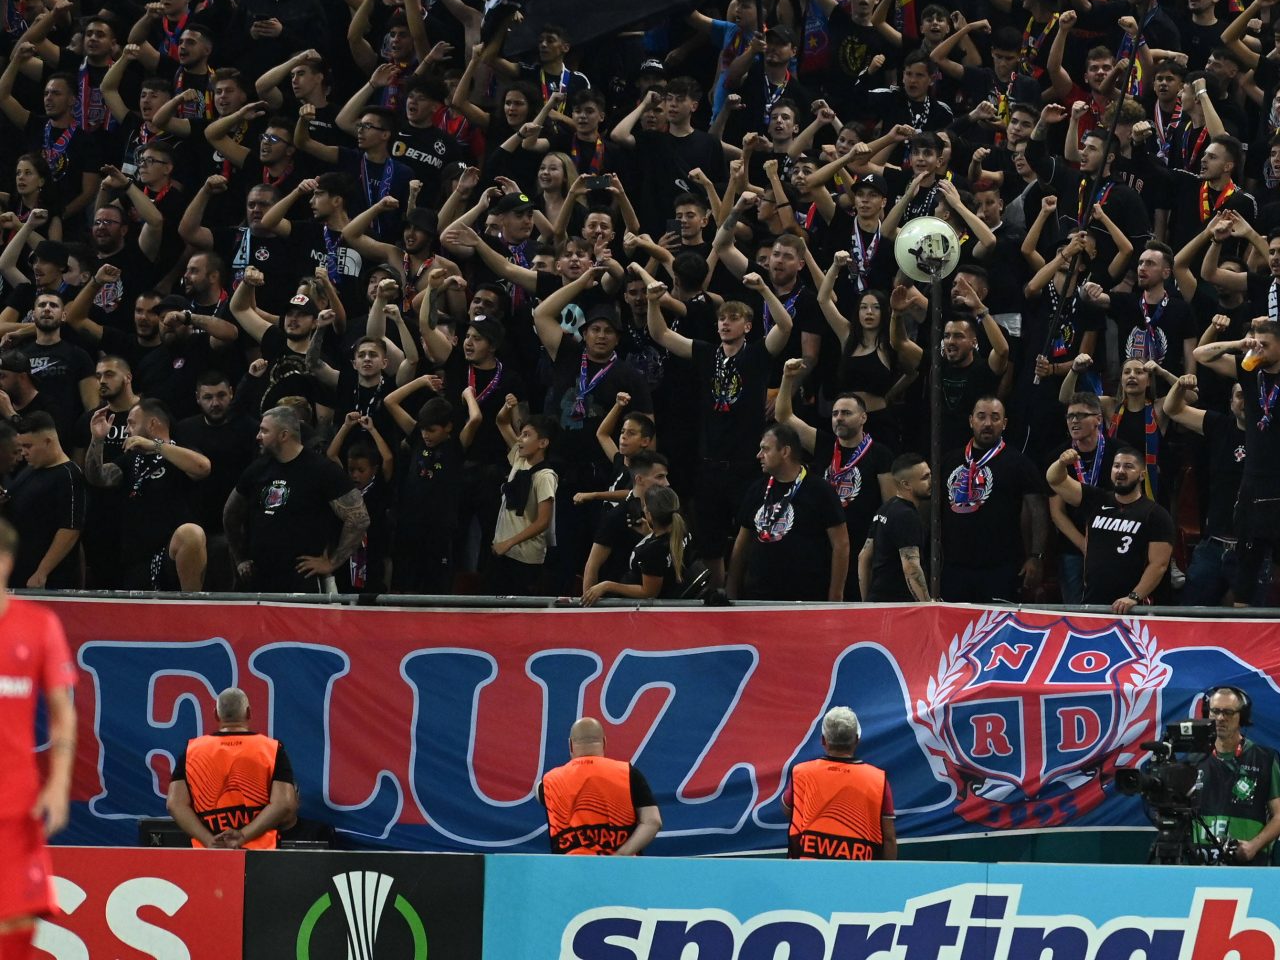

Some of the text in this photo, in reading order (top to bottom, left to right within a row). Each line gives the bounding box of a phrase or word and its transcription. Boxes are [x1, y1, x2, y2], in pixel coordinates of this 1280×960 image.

[405, 148, 443, 169] BETANO
[1092, 515, 1141, 534] MIAMI
[1116, 535, 1132, 554] 3
[984, 642, 1110, 673] N O
[36, 636, 958, 842] ELUZA
[970, 707, 1101, 757] R D
[558, 829, 629, 851] STEWARD
